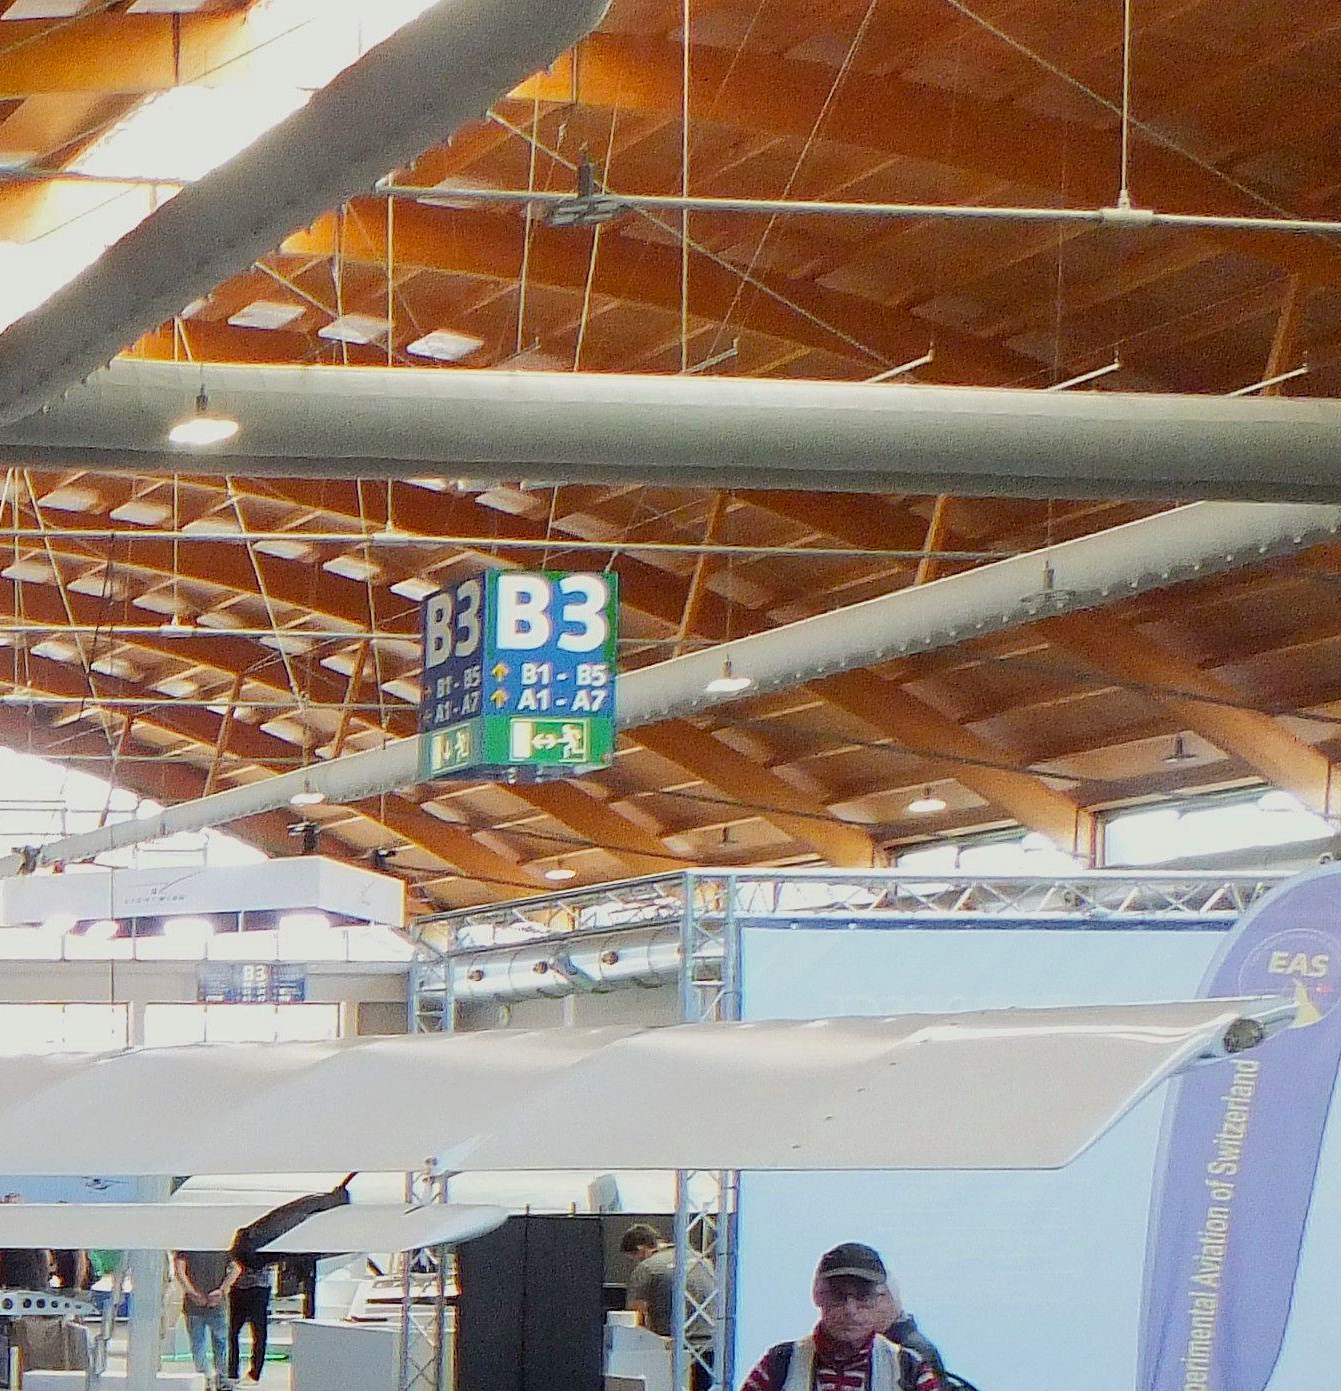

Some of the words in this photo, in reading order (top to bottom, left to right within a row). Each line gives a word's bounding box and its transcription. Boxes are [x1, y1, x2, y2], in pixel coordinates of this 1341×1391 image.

[426, 579, 482, 669] B3
[496, 574, 609, 653] B3
[517, 688, 550, 711] A1
[570, 689, 607, 712] A7
[521, 661, 551, 686] B1
[575, 662, 609, 687] B5
[1268, 950, 1330, 978] EAS
[1207, 1059, 1261, 1176] Switzerland
[1205, 1179, 1235, 1201] of
[1190, 1206, 1231, 1288] Aviation
